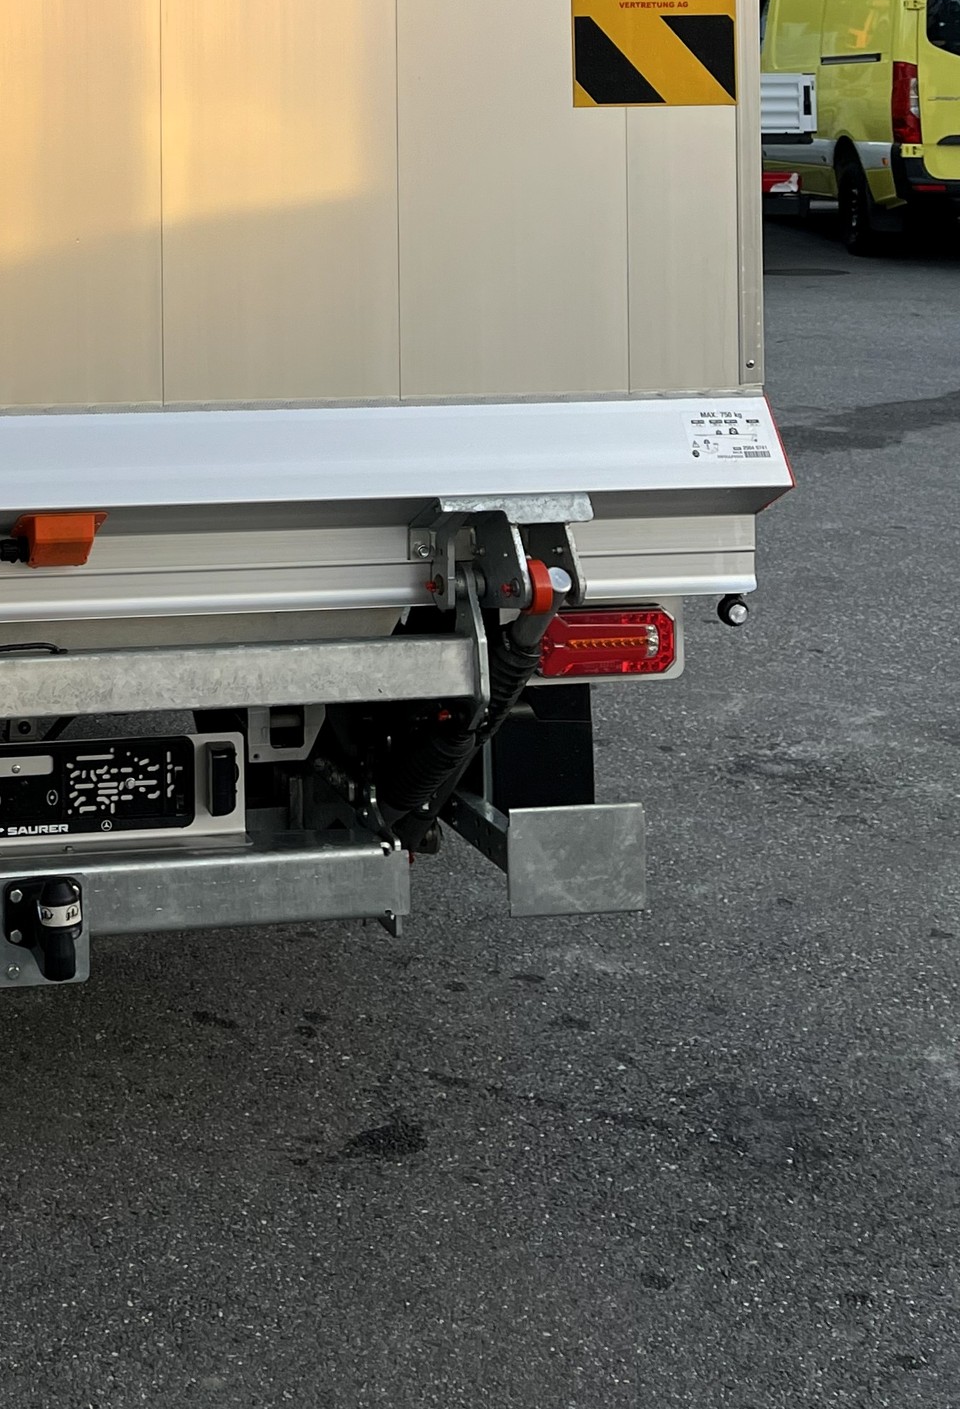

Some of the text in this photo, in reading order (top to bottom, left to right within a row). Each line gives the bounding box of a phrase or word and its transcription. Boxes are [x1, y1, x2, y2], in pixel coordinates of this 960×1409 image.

[619, 1, 689, 9] VERTRETUNG AG
[7, 824, 69, 836] SAURER
